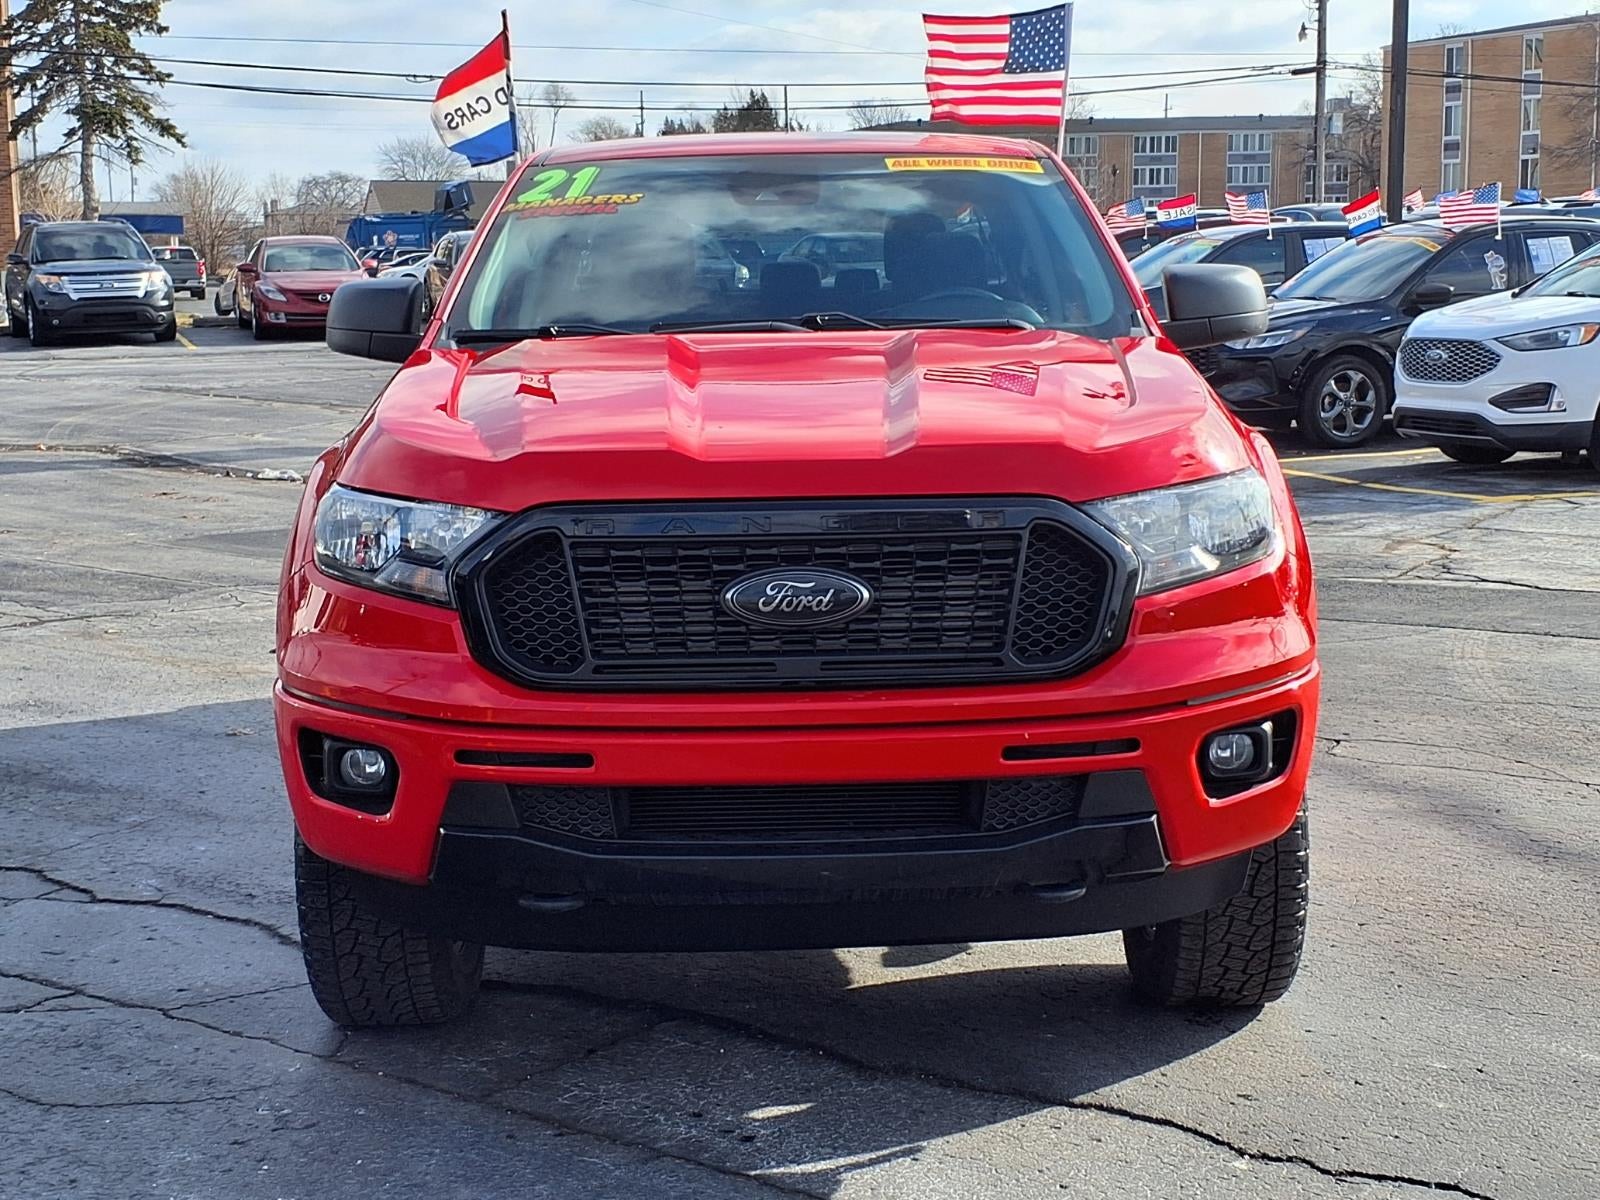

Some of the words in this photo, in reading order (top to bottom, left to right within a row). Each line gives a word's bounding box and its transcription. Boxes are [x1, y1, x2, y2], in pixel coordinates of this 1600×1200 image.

[891, 158, 923, 168] ALL
[926, 158, 982, 169] WHEEL
[987, 160, 1036, 171] DRIVE
[517, 166, 600, 203] 21
[501, 192, 645, 213] MANAGERS
[758, 580, 835, 612] Ford
